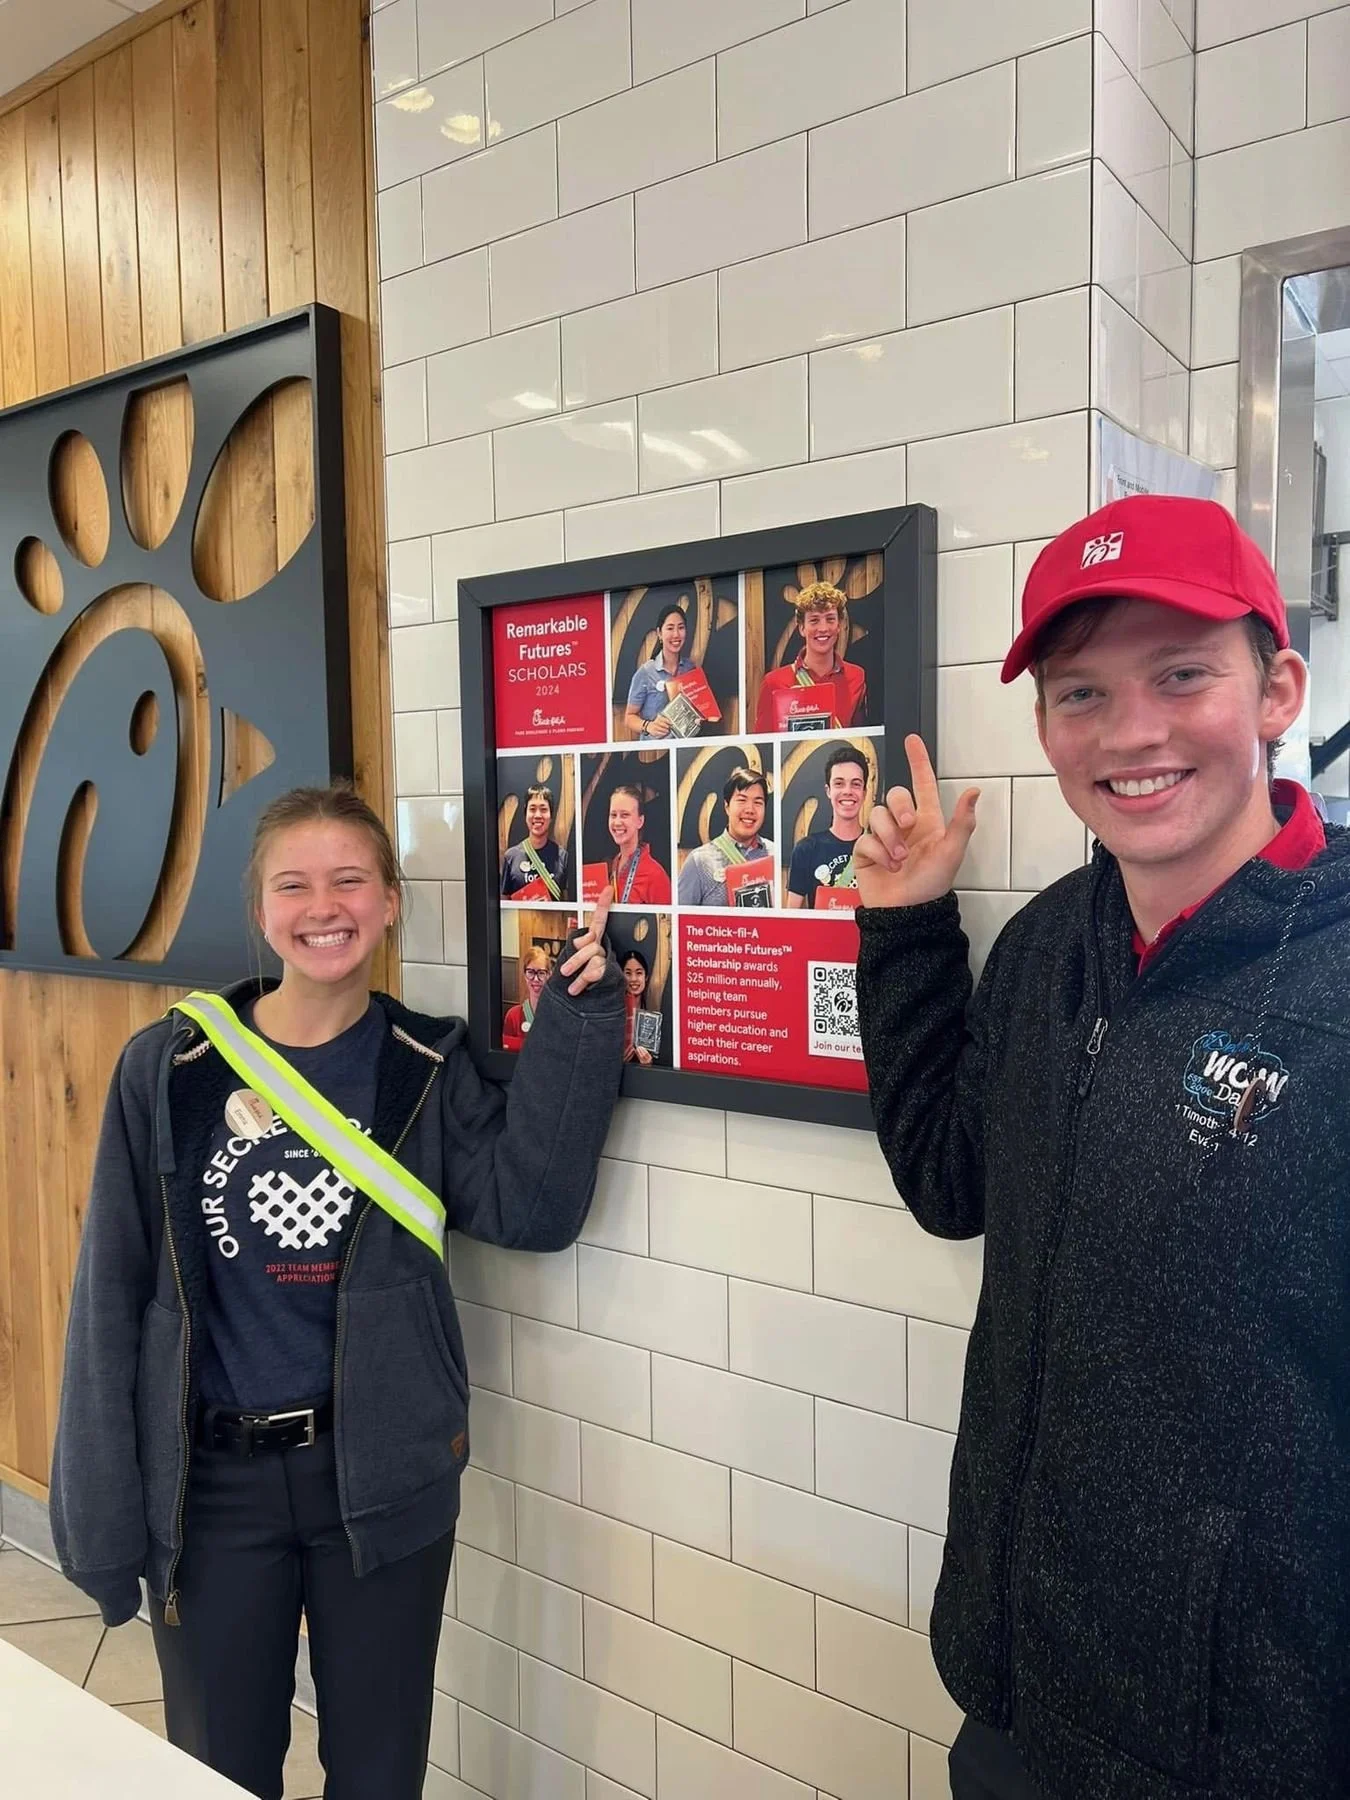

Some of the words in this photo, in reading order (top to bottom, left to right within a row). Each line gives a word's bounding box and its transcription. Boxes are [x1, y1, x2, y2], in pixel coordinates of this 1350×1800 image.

[506, 614, 588, 639] Remarkable
[508, 662, 587, 683] SCHOLARS
[535, 684, 560, 696] 2024
[686, 925, 704, 936] The
[705, 926, 759, 939] Chick-fil-A
[686, 941, 743, 954] Remarkable
[686, 957, 742, 972] Scholarship
[743, 961, 779, 973] awards
[687, 972, 704, 984] $25
[706, 974, 738, 985] million
[739, 977, 783, 991] annually,
[687, 988, 721, 1003] helping
[723, 992, 748, 1003] team
[687, 1005, 732, 1017] members
[733, 1009, 768, 1020] pursue
[687, 1019, 717, 1032] higher
[718, 1023, 767, 1037] education
[769, 1028, 788, 1039] and
[687, 1036, 714, 1047] reach
[716, 1037, 739, 1049] their
[740, 1041, 773, 1053] career
[813, 1041, 833, 1051] Join
[834, 1044, 850, 1053] our
[852, 1045, 863, 1054] te
[687, 1052, 742, 1067] aspirations.
[1182, 1105, 1220, 1130] Timoth
[284, 1149, 310, 1159] SINCE
[201, 1195, 240, 1259] OUR
[265, 1264, 286, 1274] 2022
[287, 1263, 310, 1273] TEAM
